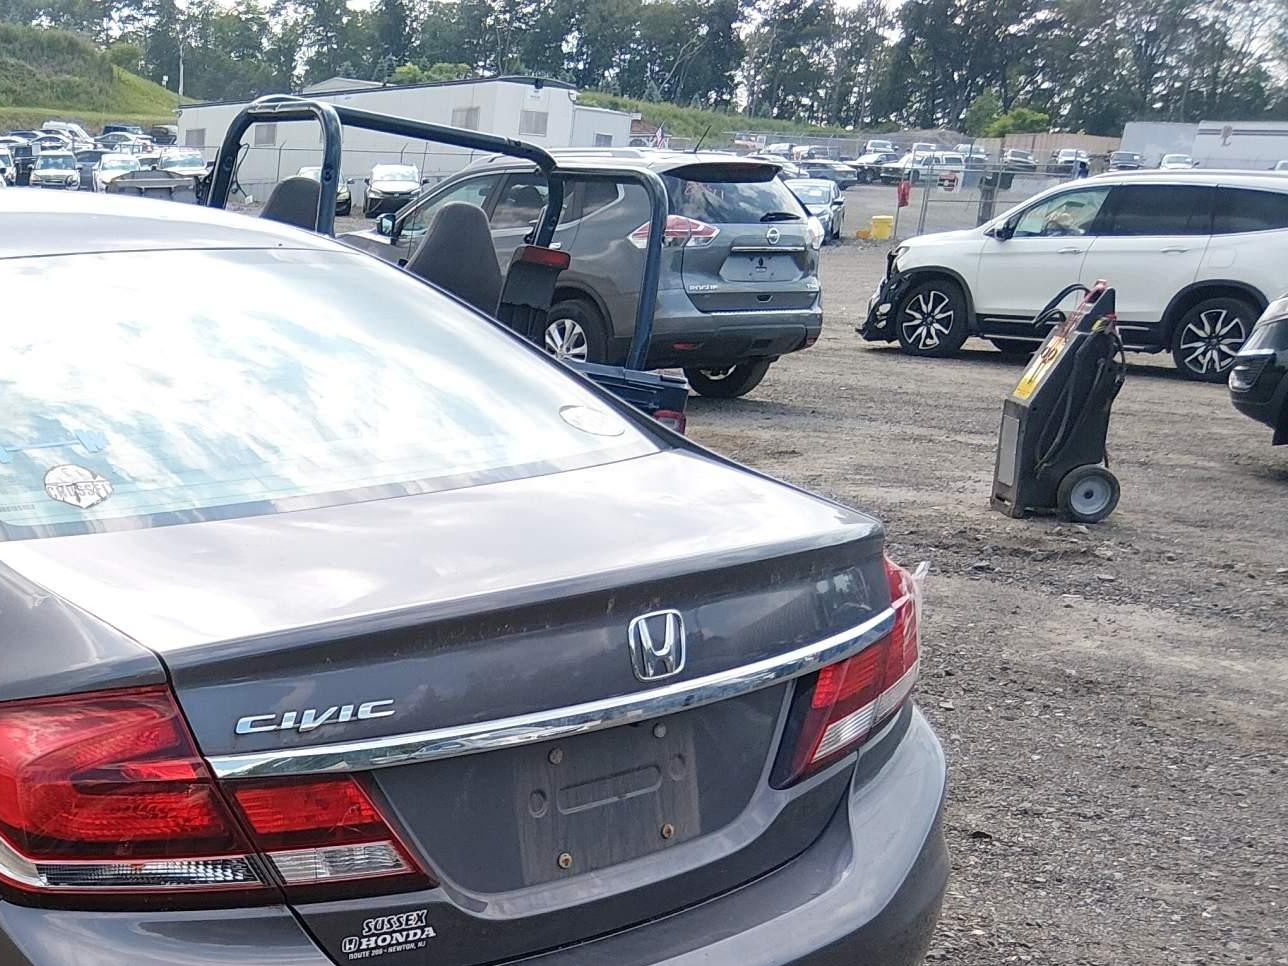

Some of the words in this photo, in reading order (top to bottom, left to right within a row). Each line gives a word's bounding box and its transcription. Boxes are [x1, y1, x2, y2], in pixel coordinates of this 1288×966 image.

[235, 699, 396, 734] CIVIC
[362, 909, 428, 936] SUSSEX
[348, 950, 370, 960] ROUTE
[417, 940, 426, 948] NJ
[359, 927, 436, 949] HONDA
